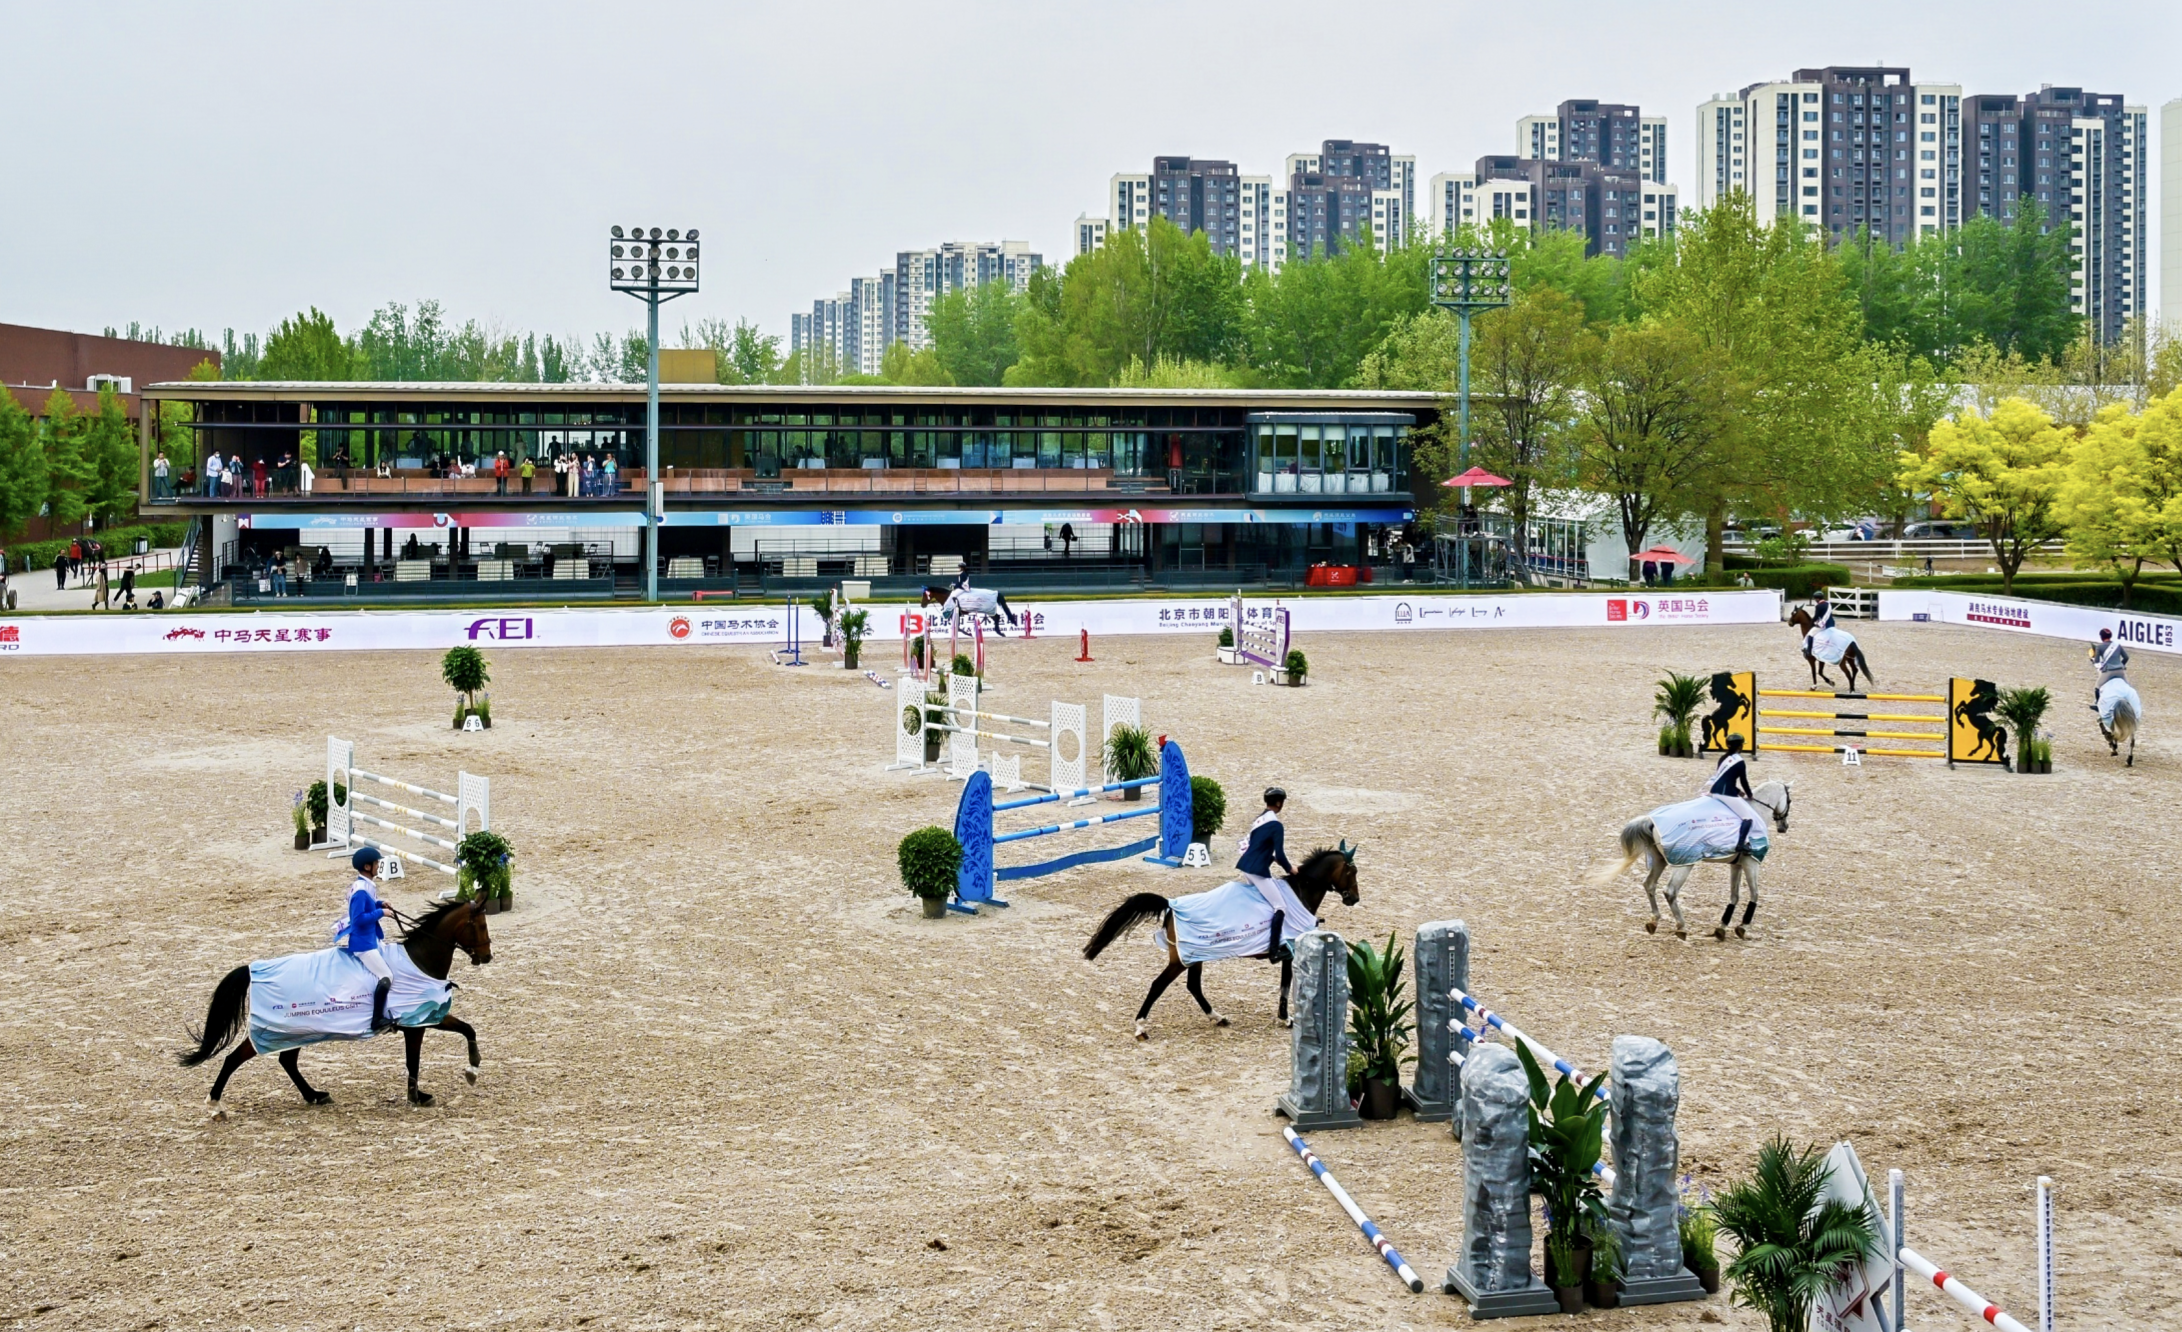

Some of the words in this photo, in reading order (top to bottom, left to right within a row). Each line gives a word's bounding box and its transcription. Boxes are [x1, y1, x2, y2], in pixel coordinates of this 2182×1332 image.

[1657, 598, 1709, 612] 英国马会
[1158, 607, 1273, 621] 北京市朝阳体育
[464, 618, 534, 640] FEI
[701, 619, 779, 631] 中国马术协会
[214, 627, 332, 643] 中马天星赛事
[2117, 620, 2164, 646] AIGLE
[2165, 625, 2174, 647] 1853
[466, 718, 472, 728] 6
[1846, 751, 1858, 762] 11
[1187, 848, 1195, 861] 5
[1199, 848, 1207, 861] 5
[389, 861, 399, 875] B
[283, 1009, 311, 1018] JUMPING
